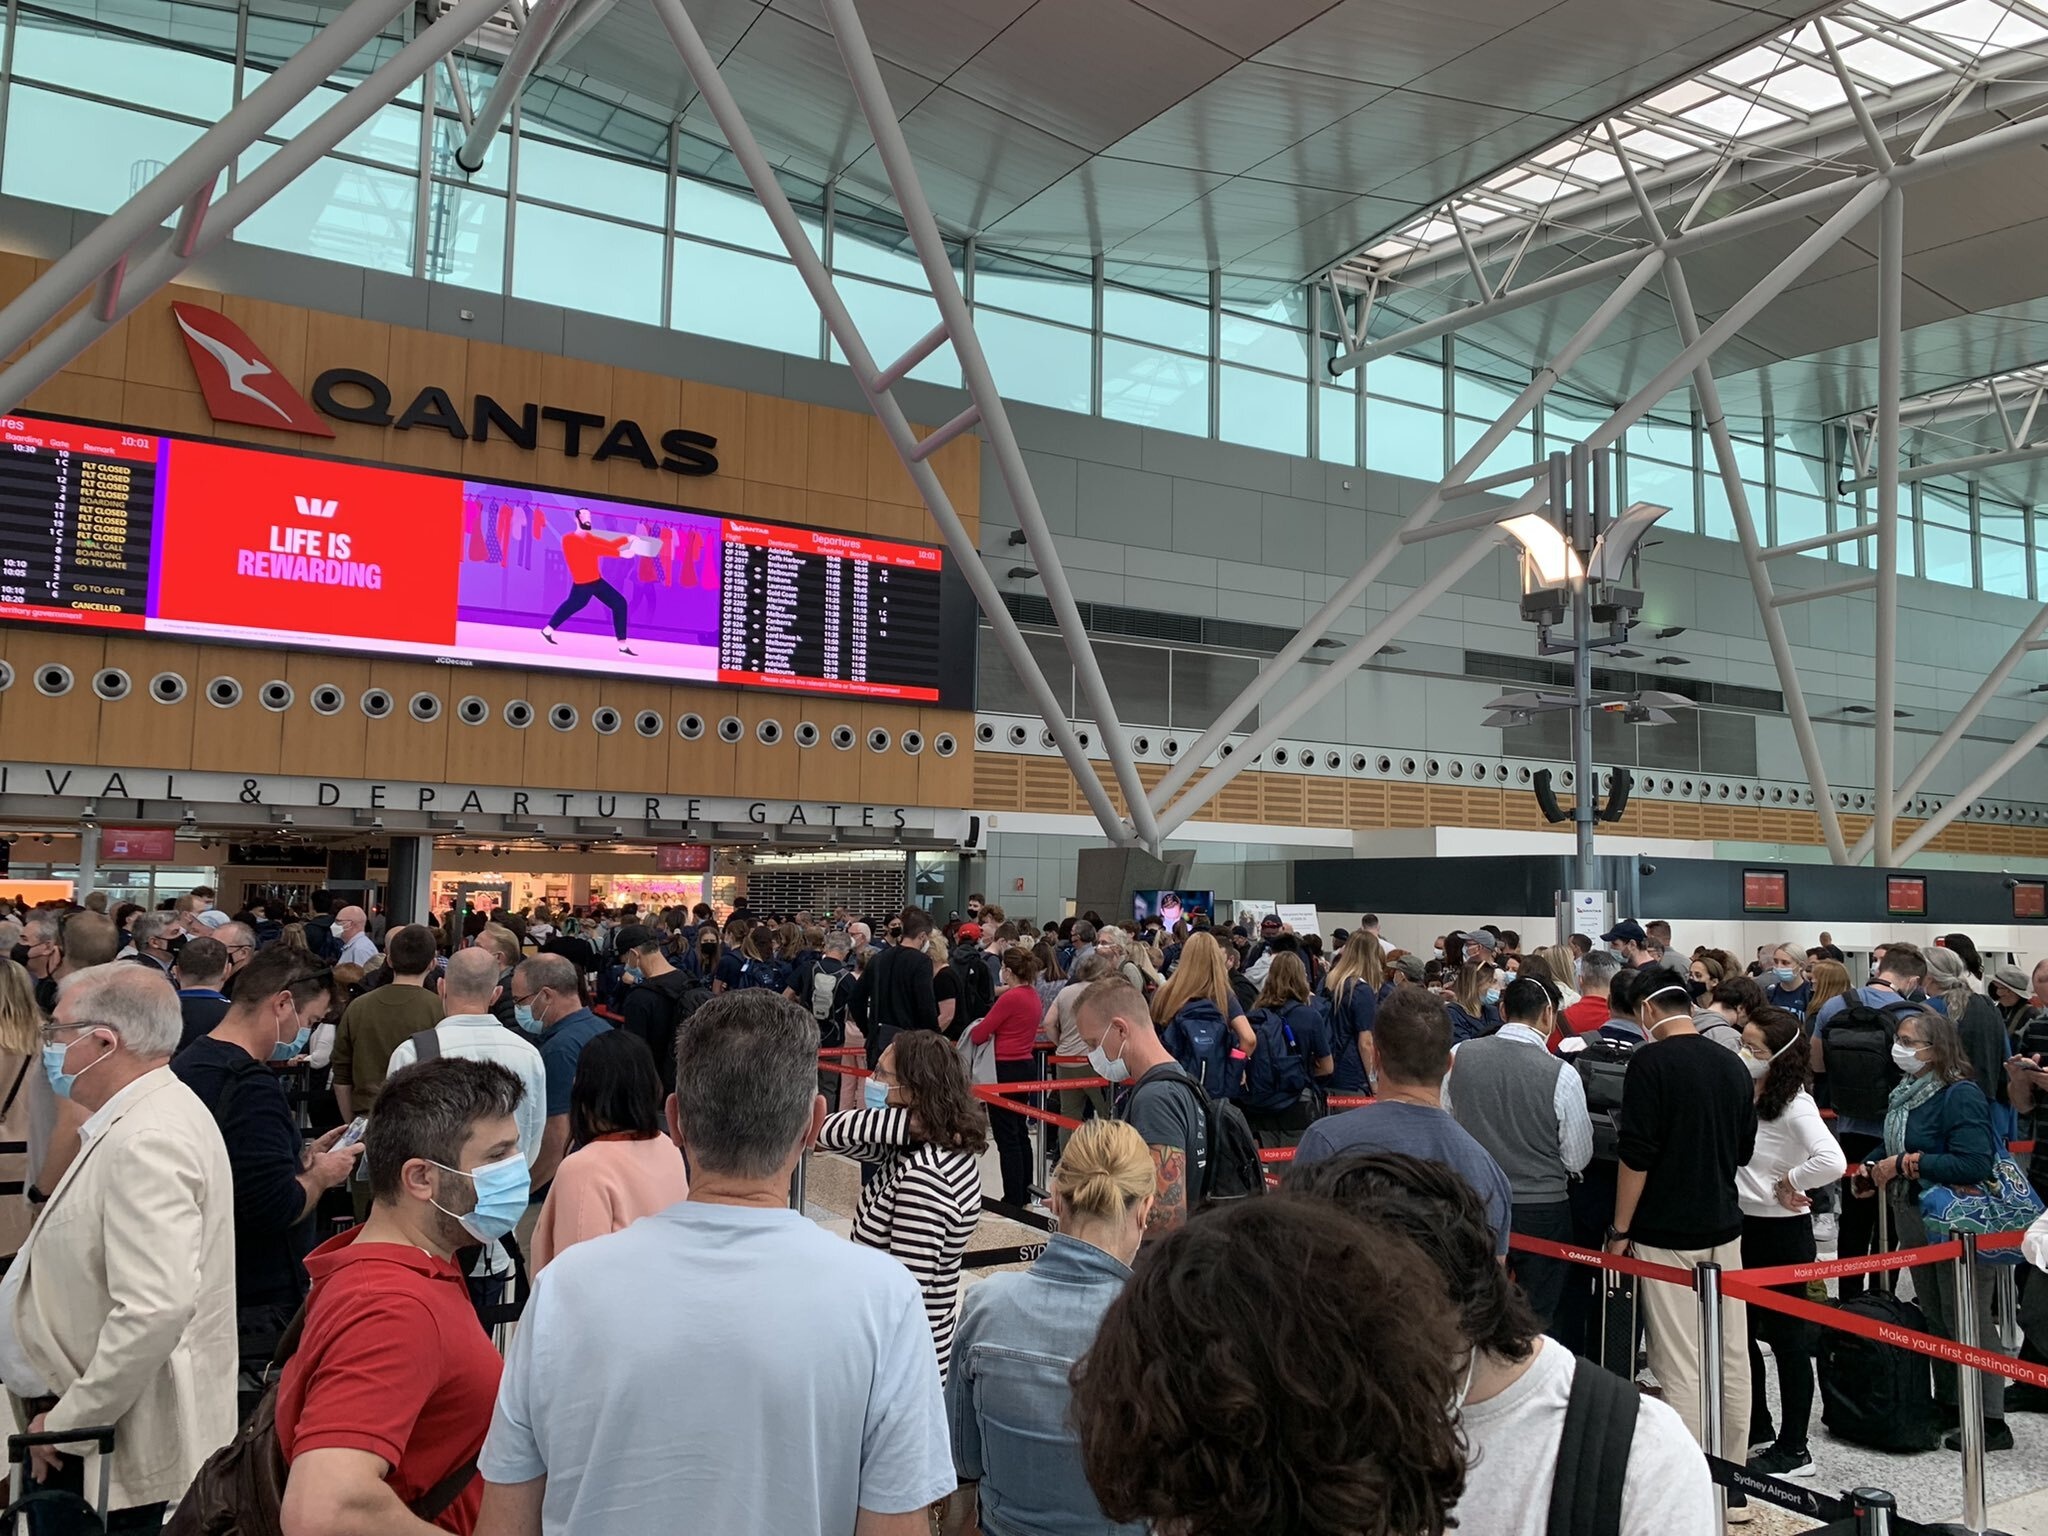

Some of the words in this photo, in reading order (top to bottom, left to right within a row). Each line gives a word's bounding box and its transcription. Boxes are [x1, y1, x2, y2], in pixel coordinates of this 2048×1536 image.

[0, 418, 24, 430] res
[312, 369, 719, 476] QANTAS
[5, 432, 42, 446] Boarding
[50, 438, 69, 448] Gate
[83, 443, 115, 454] Remark
[121, 436, 149, 448] 10:01
[12, 443, 35, 453] 10:30
[58, 449, 69, 458] 10
[61, 459, 68, 467] C
[81, 462, 96, 470] FLT
[97, 464, 130, 475] CLOSED
[62, 467, 66, 475] 1
[81, 470, 95, 479] FLT
[96, 472, 130, 483] CLOSED
[56, 476, 66, 484] 12
[80, 479, 95, 487] FLT
[96, 481, 129, 492] CLOSED
[58, 493, 65, 501] 4
[79, 496, 125, 508] BOARDING
[80, 487, 94, 496] FLT
[95, 489, 129, 500] CLOSED
[54, 502, 64, 510] 13
[79, 505, 93, 513] FLT
[94, 507, 127, 517] CLOSED
[53, 510, 63, 518] 11
[78, 513, 92, 521] FLT
[93, 515, 126, 525] CLOSED
[52, 519, 63, 527] 19
[77, 522, 92, 530] FLT
[93, 524, 126, 534] CLOSED
[77, 531, 91, 539] FLT
[92, 533, 125, 543] CLOSED
[270, 525, 322, 557] LIFE
[328, 532, 350, 560] IS
[76, 540, 100, 549] FINAL
[102, 543, 123, 551] CALL
[812, 533, 860, 549] Departures
[918, 550, 935, 559] 10:01
[75, 548, 121, 560] BOARDING
[3, 559, 27, 568] 10:10
[74, 557, 89, 565] GO
[104, 560, 126, 569] GATE
[238, 549, 381, 590] REWARDING
[3, 568, 26, 576] 10:05
[1, 586, 25, 594] 10:10
[102, 586, 125, 595] GATE
[0, 594, 24, 603] 10:20
[71, 601, 121, 611] CANCELLED
[0, 606, 30, 616] erritory
[32, 610, 83, 619] government
[435, 657, 473, 666] JCDecaux
[2, 767, 183, 800] IVAL
[238, 779, 261, 804] &
[319, 783, 701, 820] DEPARTURE
[749, 802, 906, 828] GATES
[1568, 1252, 1602, 1264] QANTAS
[1794, 1267, 1813, 1277] Make
[1814, 1267, 1828, 1276] your
[1830, 1264, 1843, 1273] first
[1844, 1258, 1880, 1271] destination
[1881, 1254, 1917, 1267] qantas.com
[1879, 1327, 1909, 1344] Make
[1912, 1338, 1937, 1353] your
[1941, 1343, 1962, 1360] first
[1965, 1351, 2035, 1380] destination
[1734, 1472, 1767, 1493] Sydney
[1767, 1485, 1801, 1504] Airport
